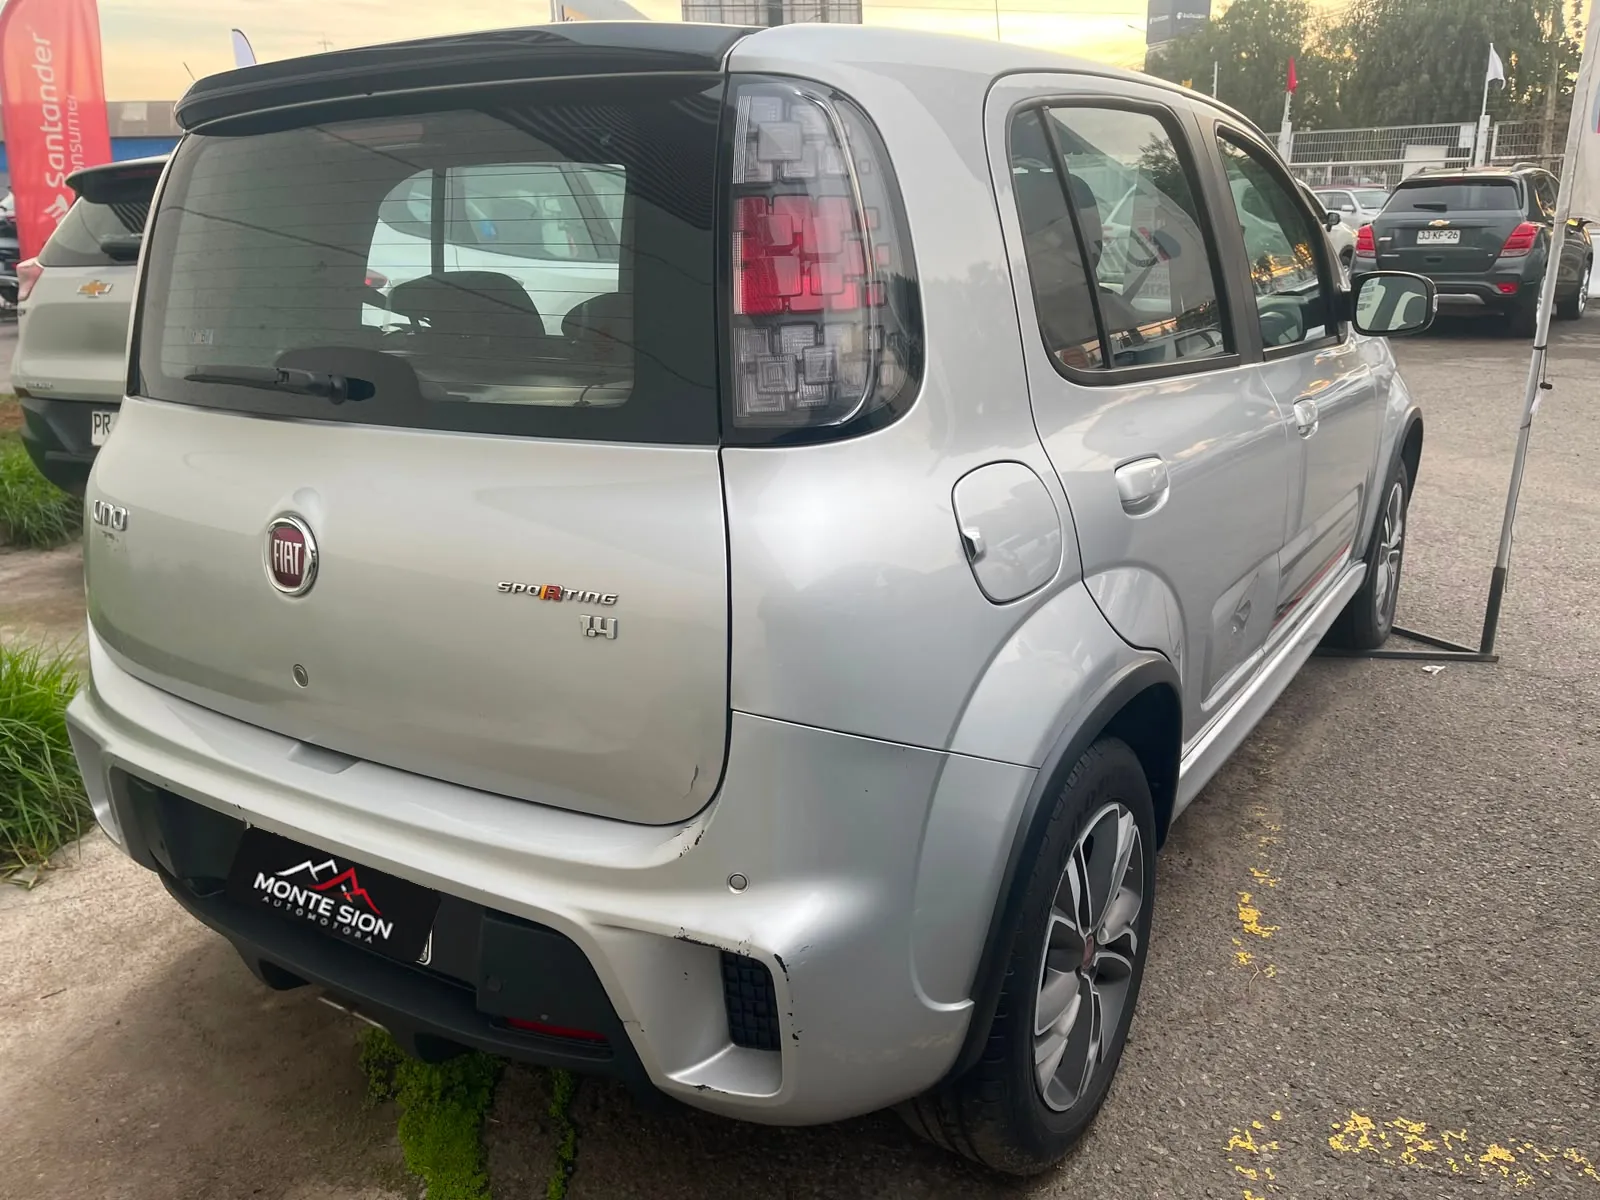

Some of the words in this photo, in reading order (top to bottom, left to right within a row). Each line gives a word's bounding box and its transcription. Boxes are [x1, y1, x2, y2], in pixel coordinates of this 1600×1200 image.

[31, 32, 66, 188] Santander
[66, 94, 85, 174] onsumer
[273, 538, 303, 576] FIAT
[580, 613, 618, 640] 1.4
